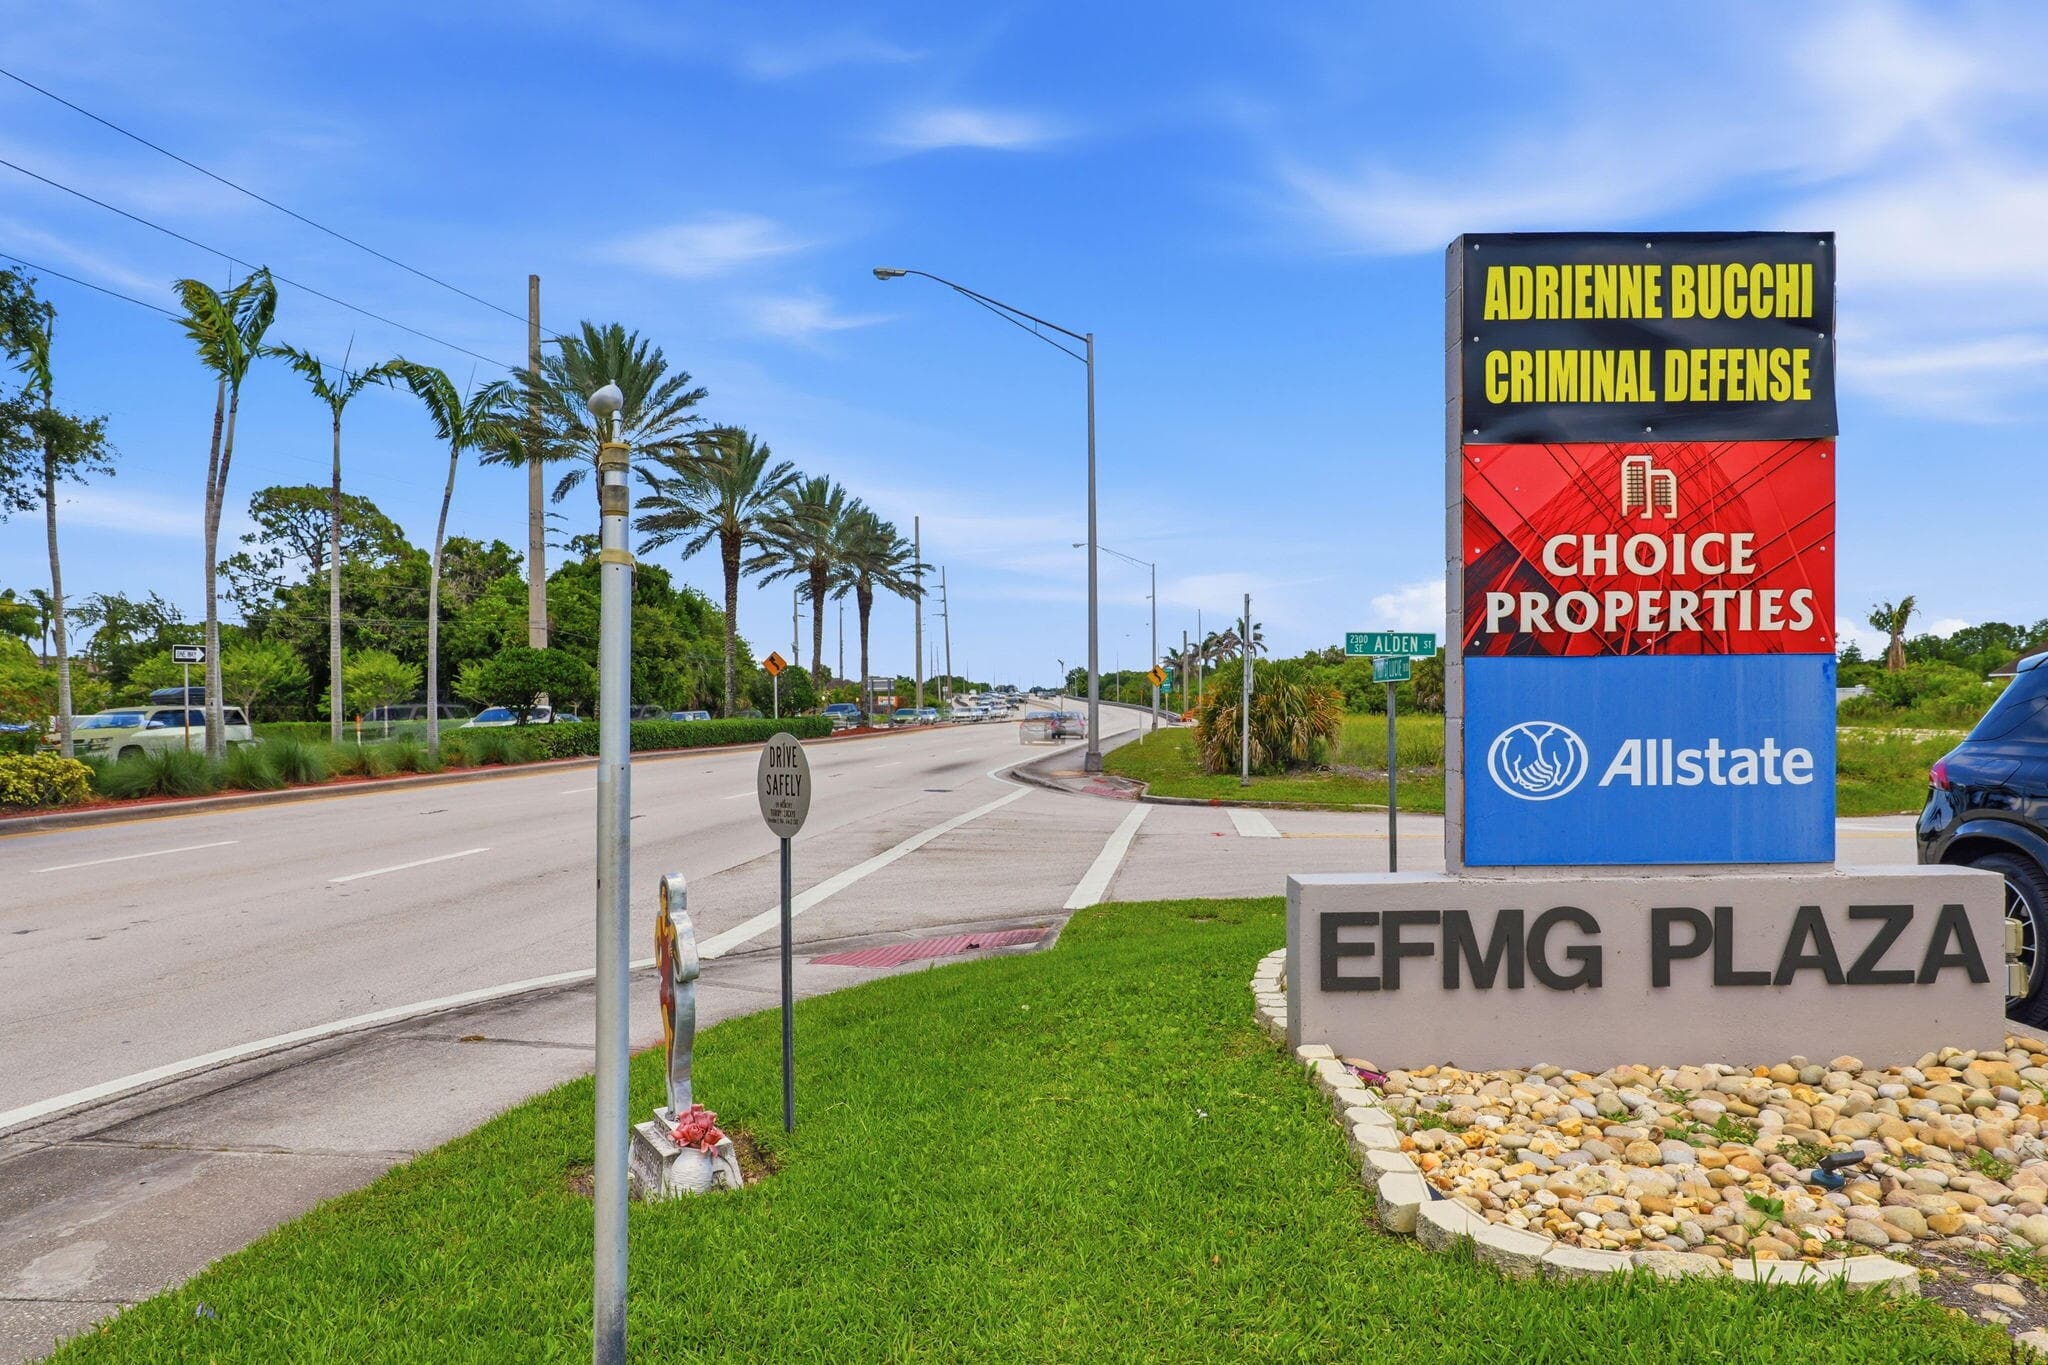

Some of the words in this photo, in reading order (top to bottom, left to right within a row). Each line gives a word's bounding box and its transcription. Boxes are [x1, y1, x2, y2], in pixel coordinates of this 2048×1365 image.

[1484, 264, 1663, 321] ADRIENNE
[1671, 262, 1813, 320] BUCCHI
[1484, 349, 1656, 404] CRIMINAL
[1664, 347, 1812, 402] DEFENSE
[1542, 532, 1756, 577] CHOICE
[1485, 588, 1815, 634] PROPERTIES
[1350, 635, 1368, 644] 2300
[1354, 644, 1363, 652] SE
[1374, 636, 1418, 652] ALDEN
[769, 745, 798, 768] DRIVE
[1598, 737, 1814, 787] Allstate
[766, 774, 802, 796] SAFELY
[1319, 905, 1602, 991] EFMG
[1650, 904, 1991, 988] PLAZA
